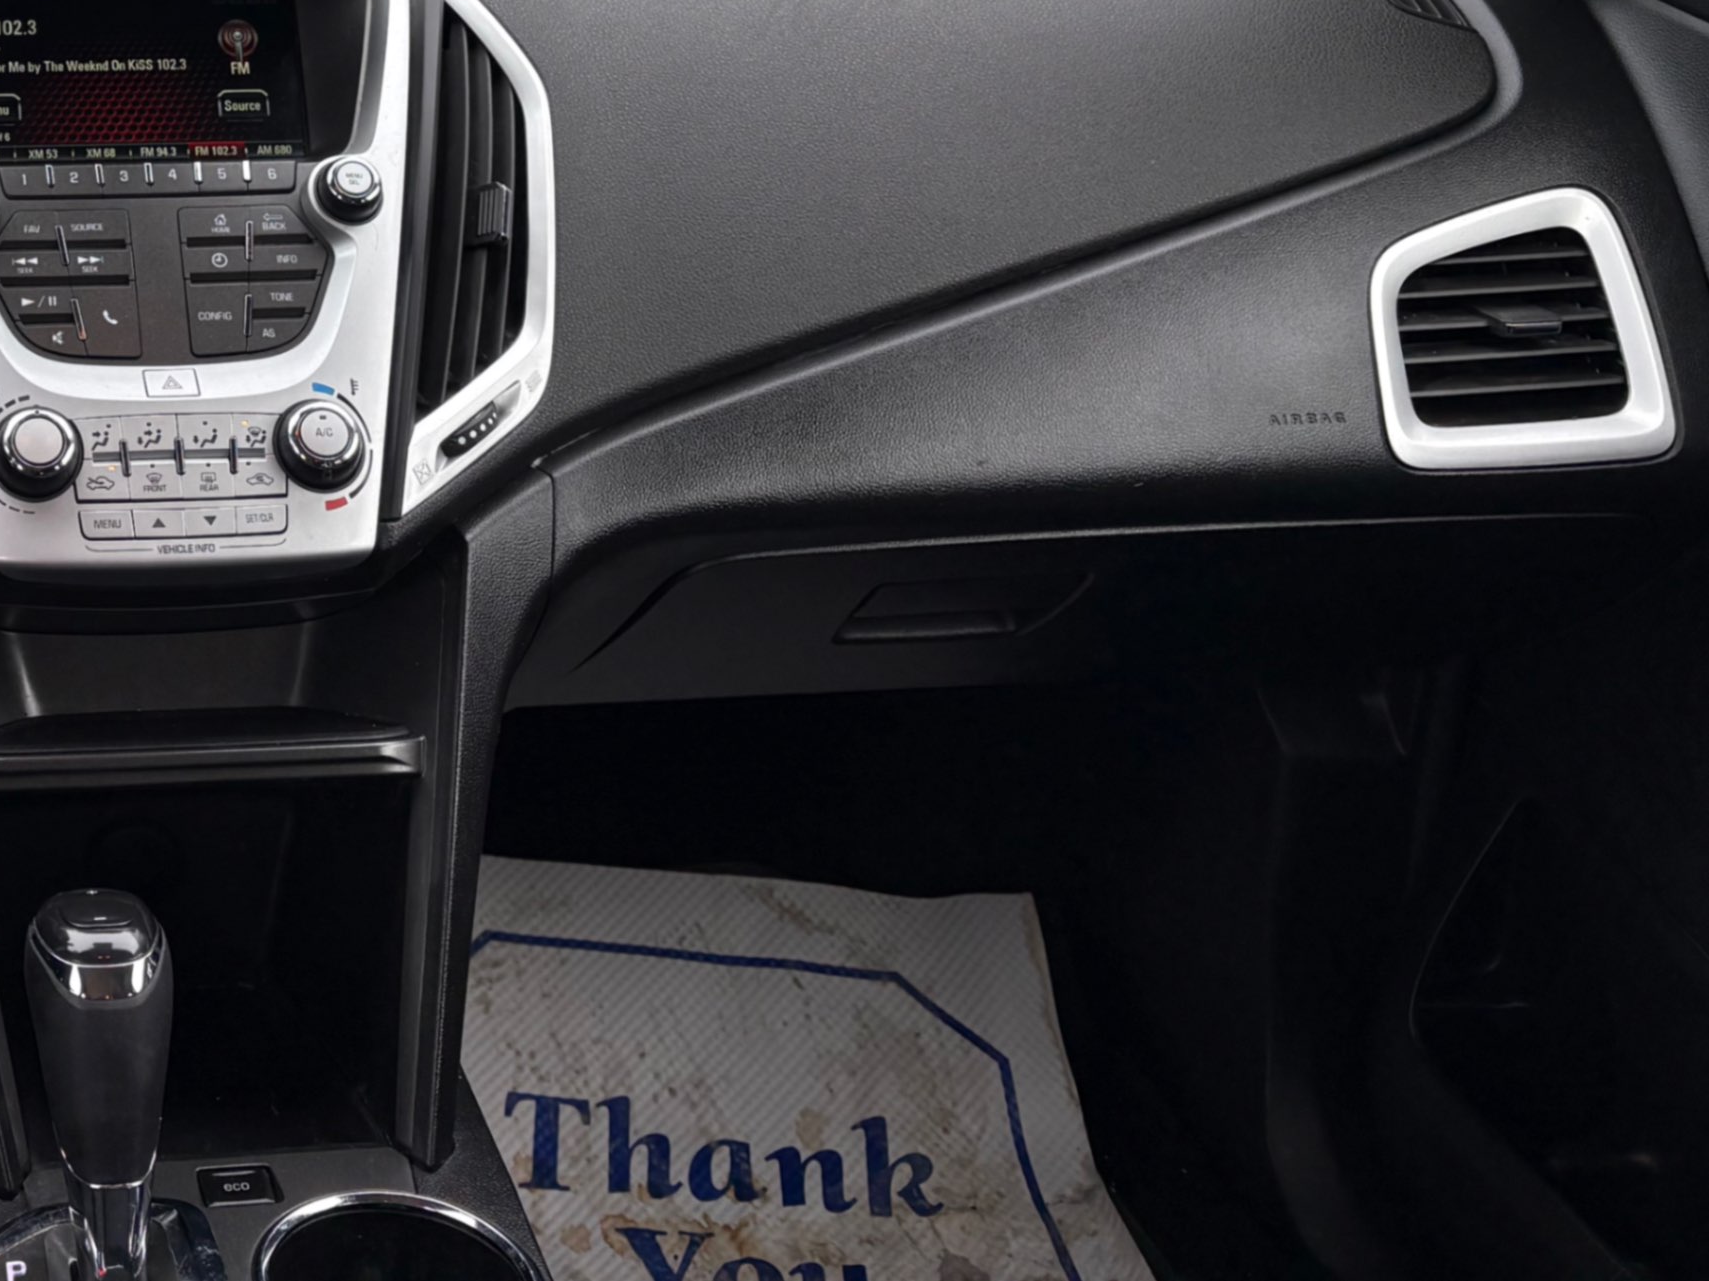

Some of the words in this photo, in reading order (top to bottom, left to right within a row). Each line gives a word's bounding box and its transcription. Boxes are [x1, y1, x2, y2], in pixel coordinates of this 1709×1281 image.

[8, 60, 25, 73] Me
[27, 60, 41, 75] by
[43, 60, 64, 72] The
[65, 59, 109, 72] Weeknd
[111, 59, 126, 71] On
[128, 58, 153, 71] KiSS
[156, 58, 187, 71] 102.3
[230, 61, 250, 75] FM
[224, 100, 261, 112] Source
[4, 132, 11, 142] 6
[28, 149, 44, 160] XM
[46, 149, 58, 159] 53
[86, 148, 102, 159] XM
[103, 148, 116, 158] 68
[140, 147, 155, 157] FM
[156, 146, 177, 157] 94.3
[195, 146, 209, 156] FM
[212, 145, 237, 156] 102.3
[257, 145, 272, 155] AM
[69, 171, 79, 183] 2
[119, 170, 129, 182] 3
[168, 168, 177, 180] 4
[217, 168, 227, 179] 5
[267, 168, 277, 179] 6
[22, 173, 27, 186] 1
[23, 224, 40, 233] FAV
[70, 223, 103, 232] SOURCE
[261, 221, 286, 231] BACK
[276, 254, 298, 264] INFO
[270, 292, 294, 302] TONE
[197, 312, 232, 321] CONFIG
[262, 328, 276, 338] AS
[315, 427, 333, 438] A/C
[143, 483, 166, 493] FRONT
[199, 483, 219, 492] REAR
[93, 519, 121, 529] MENU
[157, 544, 194, 554] VEHICLE
[195, 543, 216, 553] INFO
[504, 1091, 944, 1217] Thank
[223, 1181, 250, 1192] eco
[5, 1260, 27, 1281] P
